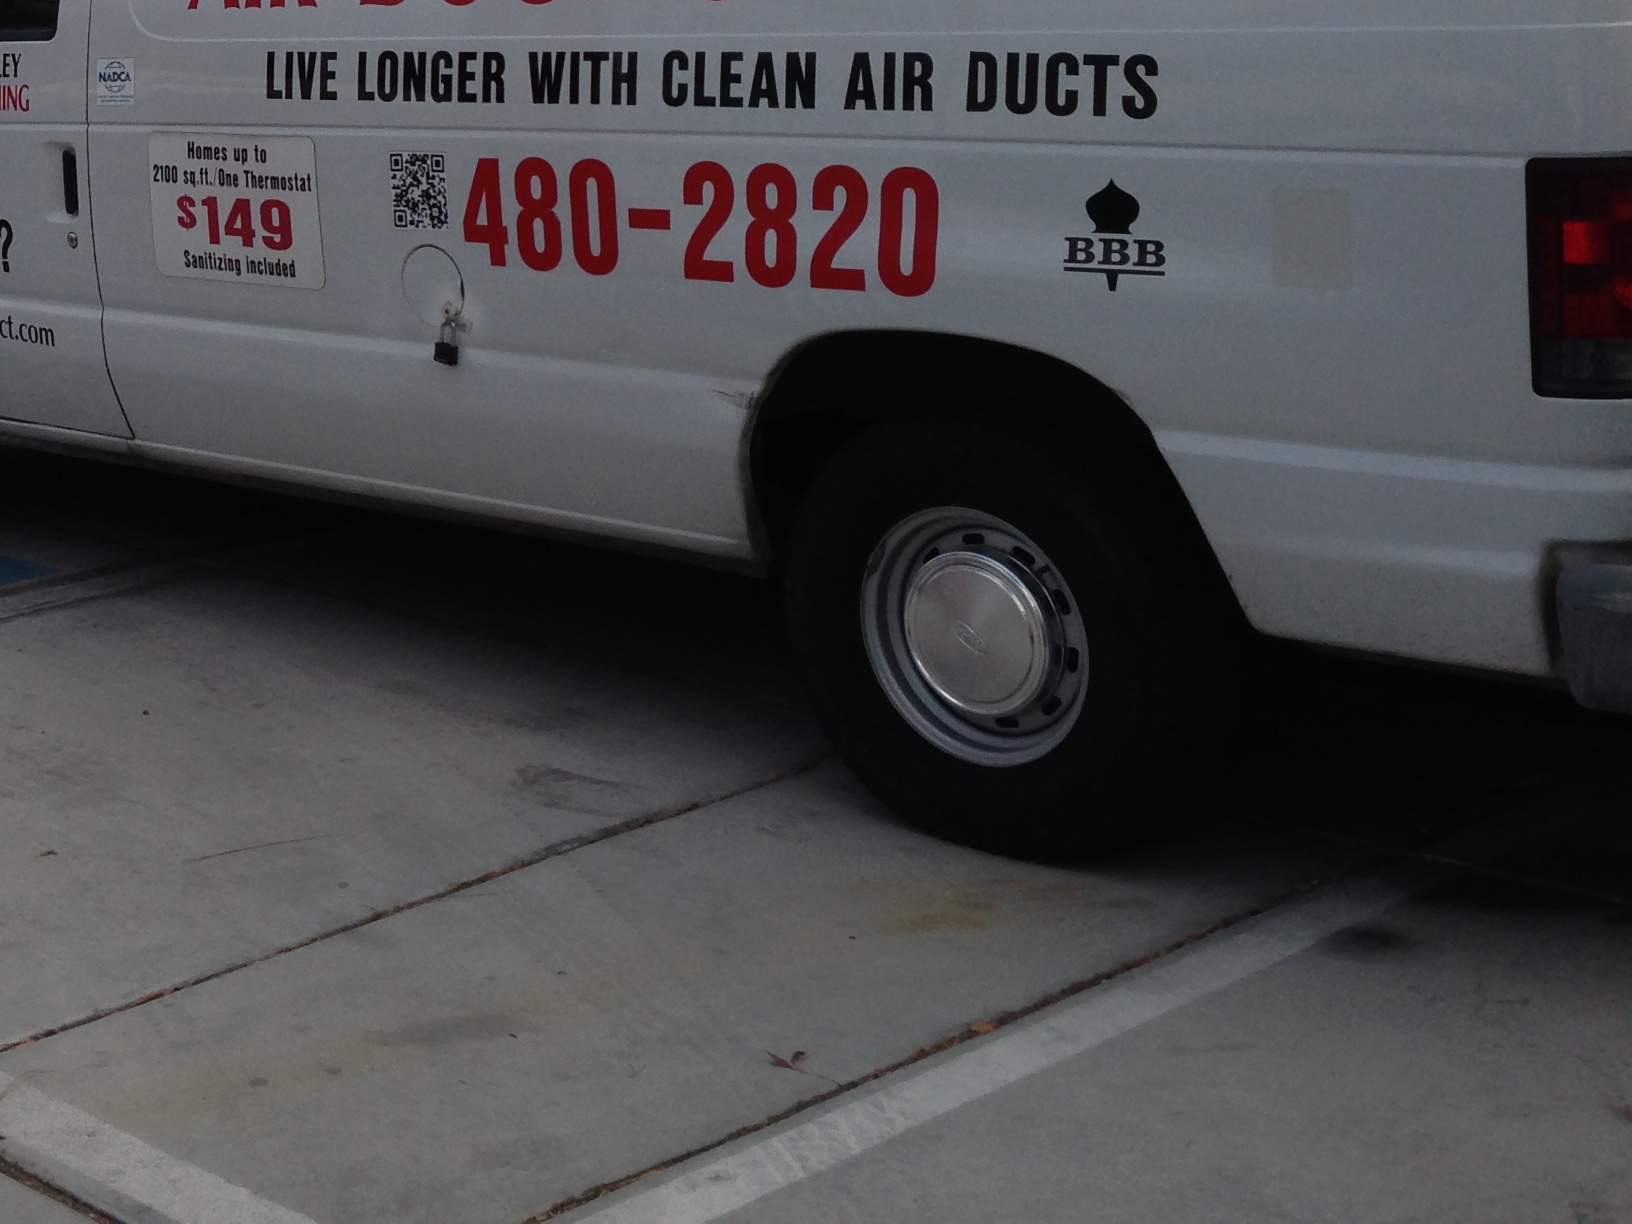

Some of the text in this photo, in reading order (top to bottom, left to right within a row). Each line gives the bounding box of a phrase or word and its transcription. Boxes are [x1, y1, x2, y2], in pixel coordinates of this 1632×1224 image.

[98, 71, 132, 83] NADCA
[266, 50, 1159, 120] LIVE LONGER WITH CLEAN AIR DUCTS
[187, 141, 267, 165] Homes up to
[153, 164, 178, 184] 2100
[243, 169, 312, 193] Thermostat
[176, 193, 293, 251] $149
[464, 156, 940, 298] 480-2820
[183, 249, 296, 278] Sanitizing included
[1064, 236, 1166, 269] BBB
